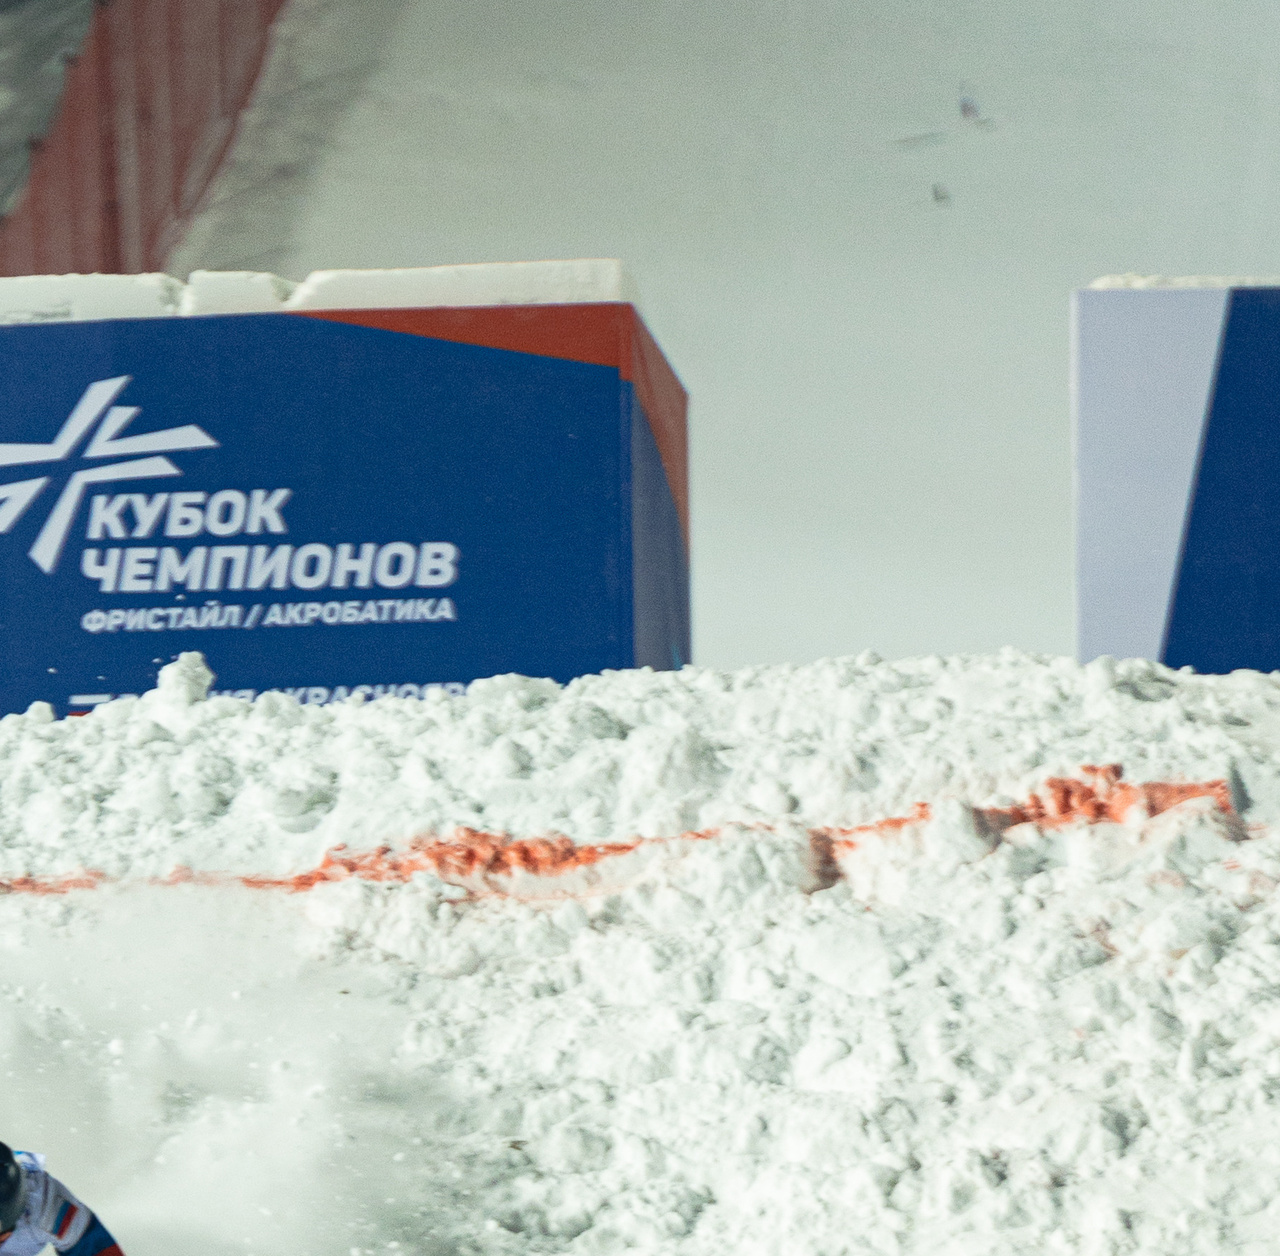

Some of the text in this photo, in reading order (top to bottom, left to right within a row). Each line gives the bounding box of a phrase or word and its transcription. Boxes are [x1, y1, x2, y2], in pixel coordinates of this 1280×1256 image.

[86, 488, 291, 540] КУБОК
[81, 541, 459, 592] ЧЕМПИОНОВ
[81, 600, 242, 632] ФРИСТАЙЛ
[261, 598, 456, 627] АКРОБАТИКА
